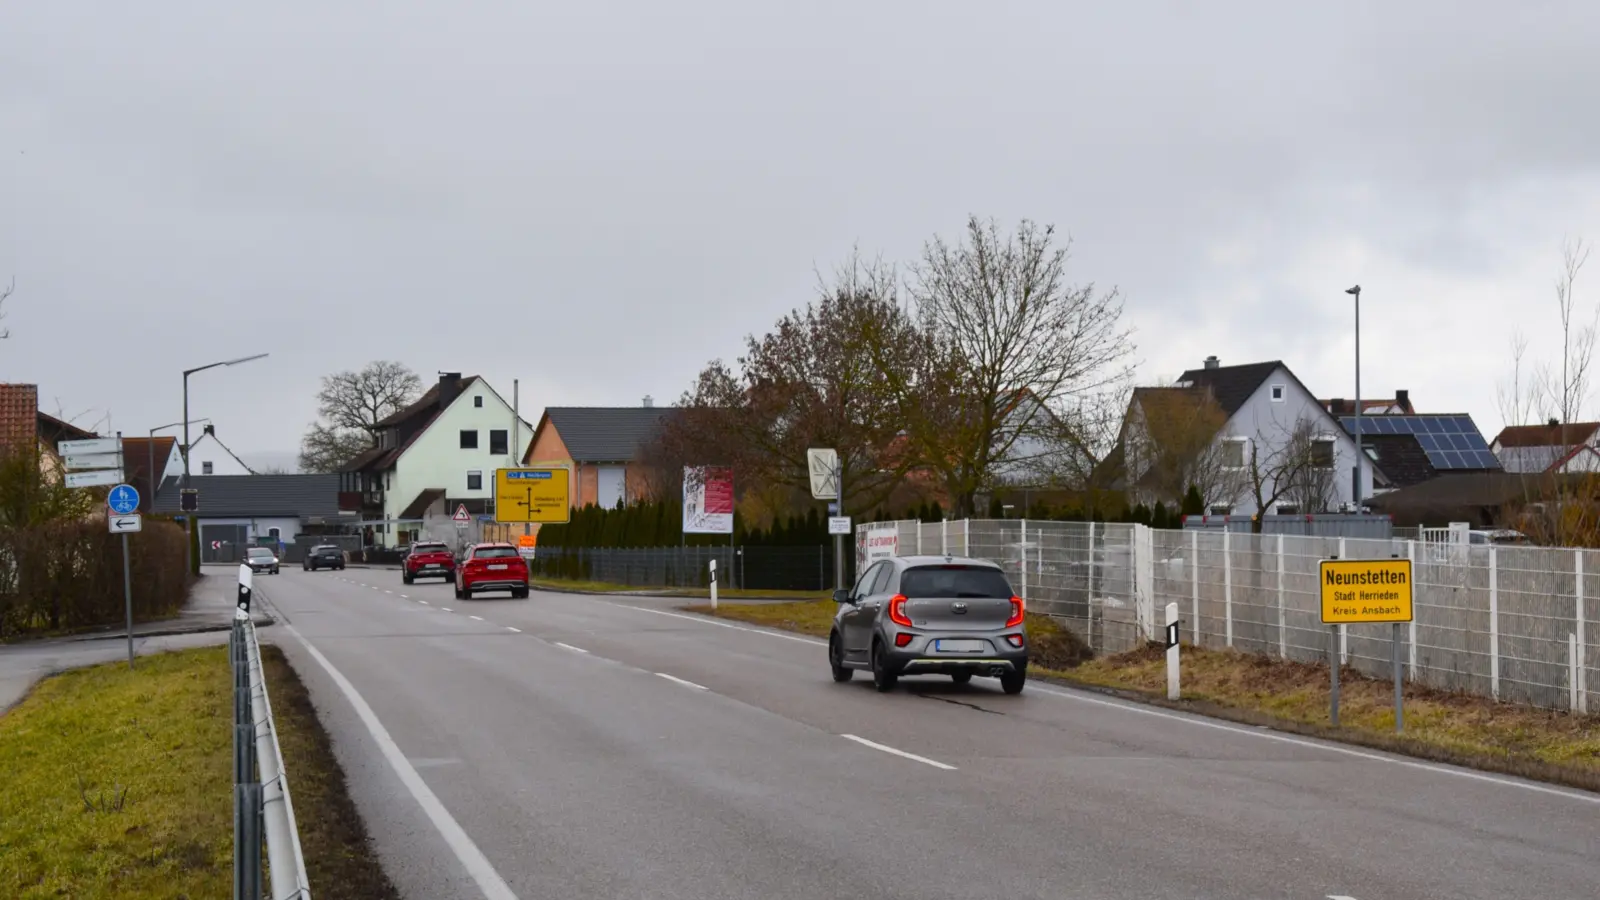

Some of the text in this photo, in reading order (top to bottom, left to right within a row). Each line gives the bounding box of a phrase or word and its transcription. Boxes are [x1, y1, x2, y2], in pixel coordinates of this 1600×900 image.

[1326, 569, 1406, 585] Neunstetten
[1334, 590, 1399, 601] Stadt Herrieden
[1333, 606, 1401, 615] Kreis Ansbach
